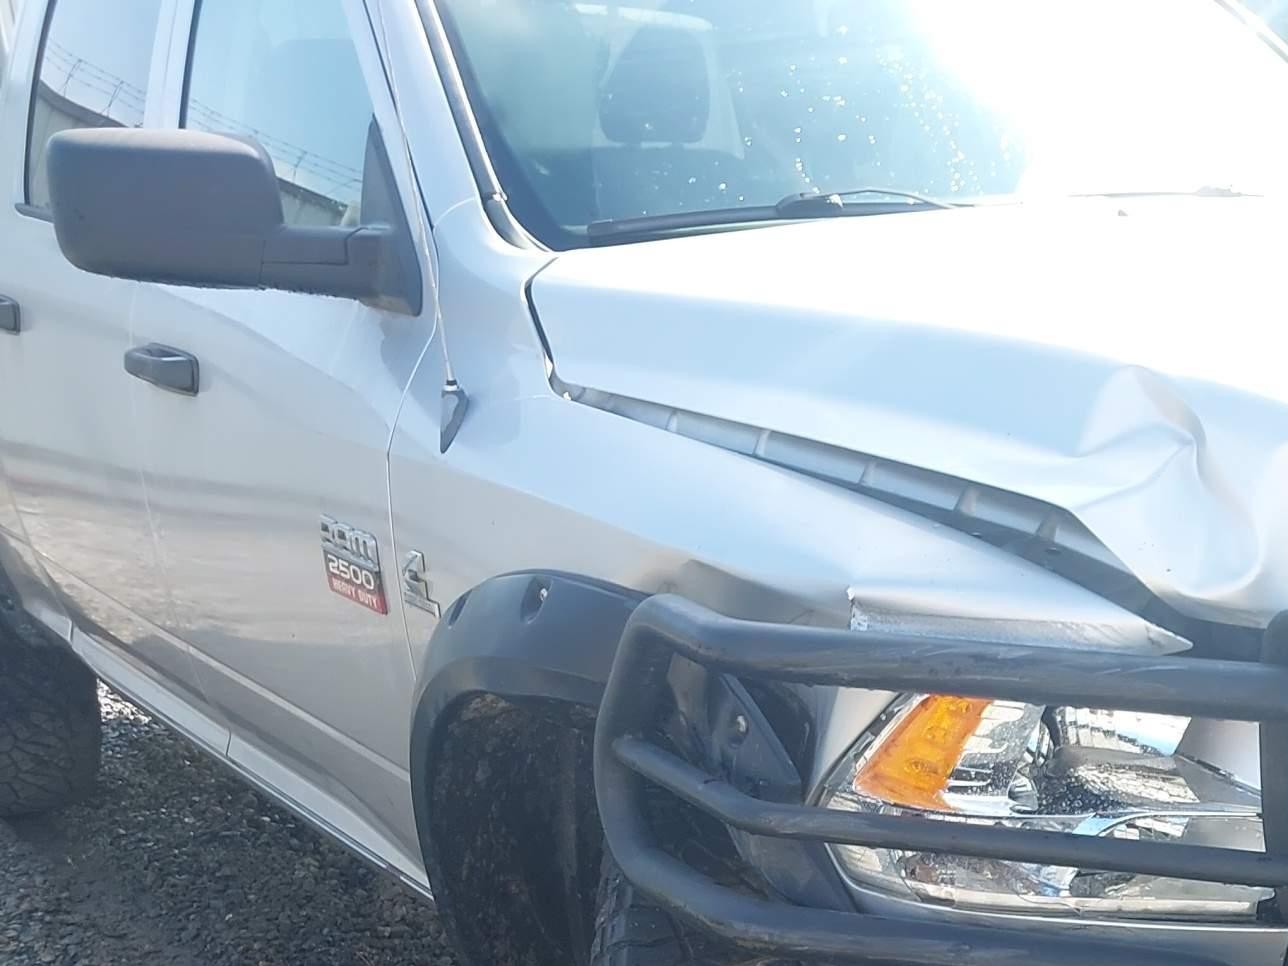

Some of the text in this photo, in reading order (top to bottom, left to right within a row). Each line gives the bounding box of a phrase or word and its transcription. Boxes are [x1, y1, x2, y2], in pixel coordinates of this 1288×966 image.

[327, 554, 375, 590] 2500
[332, 576, 356, 599] HEAVY
[358, 587, 378, 608] DUTY
